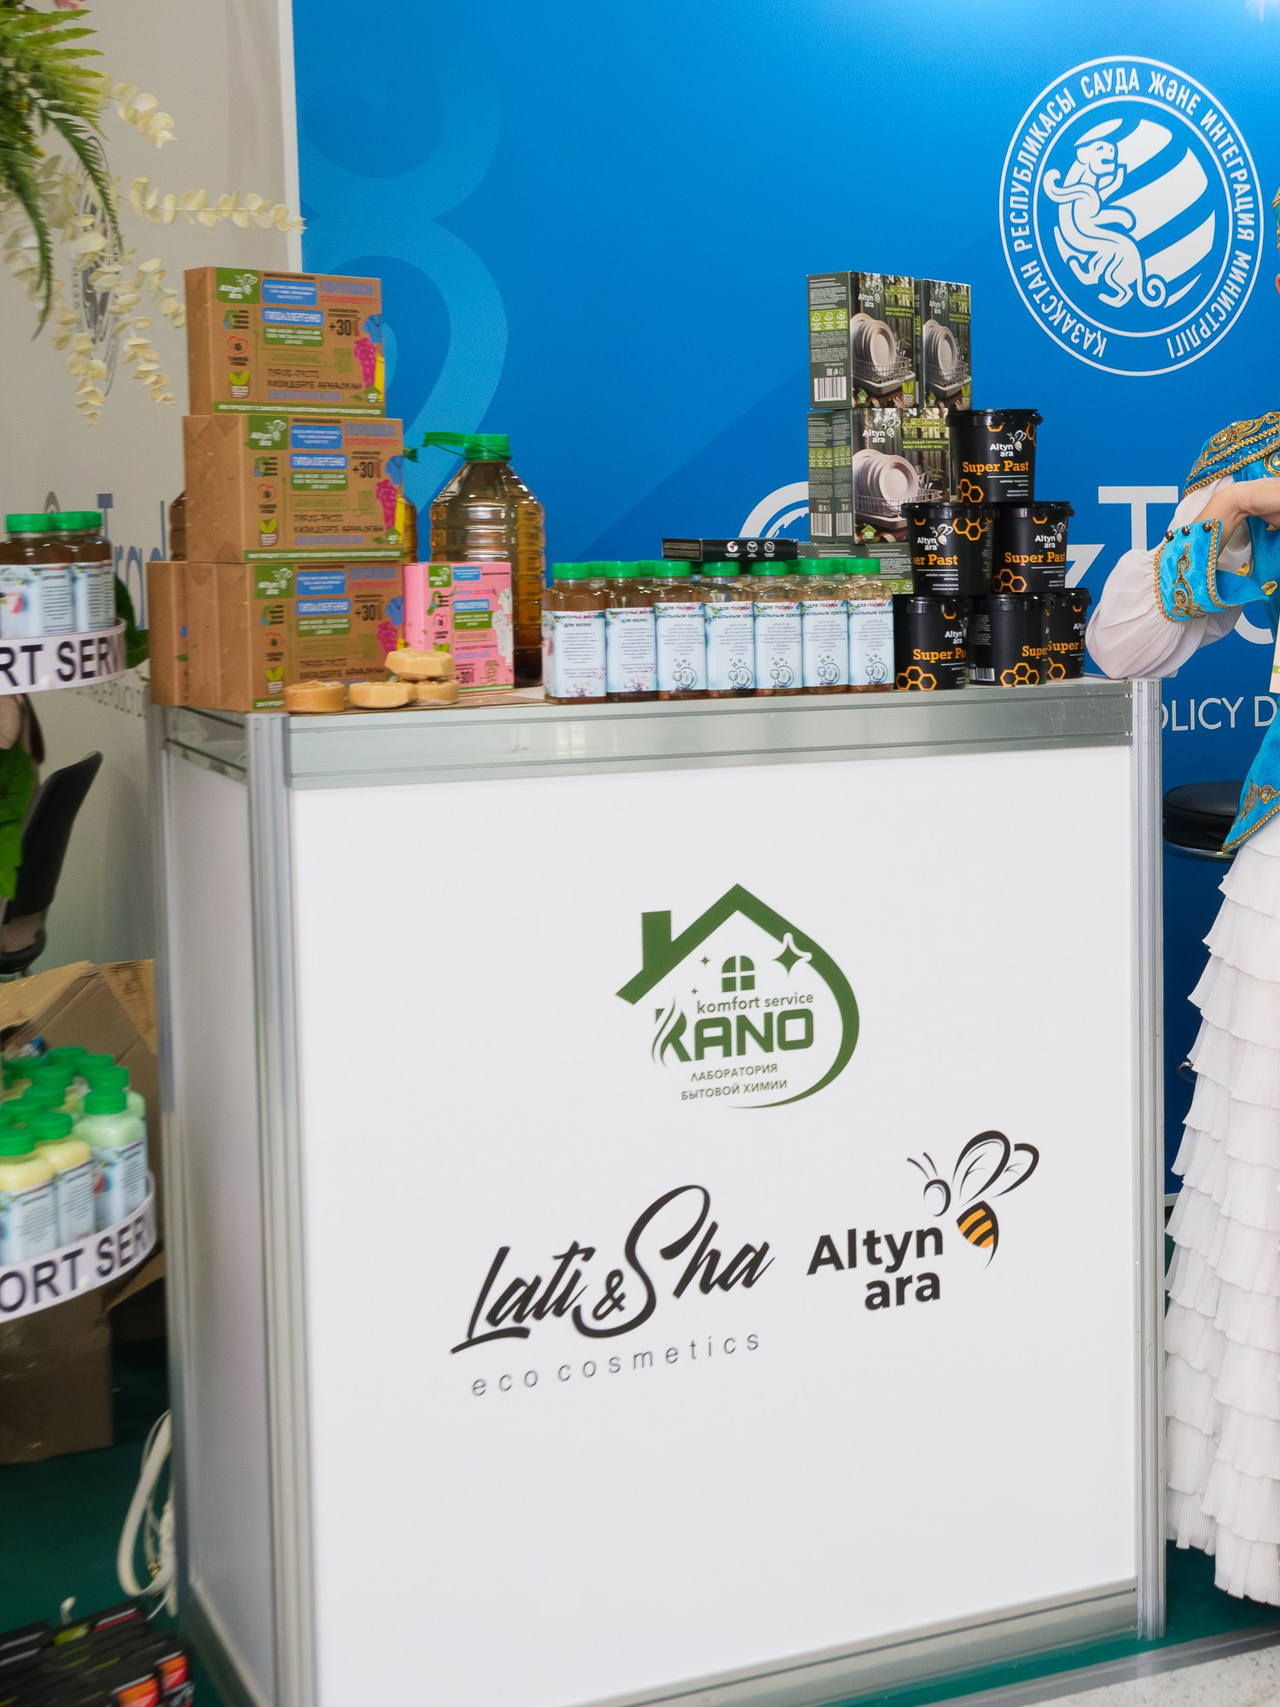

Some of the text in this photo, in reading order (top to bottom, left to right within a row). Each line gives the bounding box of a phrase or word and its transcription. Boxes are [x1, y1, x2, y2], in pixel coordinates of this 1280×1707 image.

[1010, 67, 1254, 359] ҚАЗАҚСТАН РЕСПУБЛИКАСЫ САУДА ЖӘНЕ ИНТЕГРАЦИЯ МИНИСТРЛІГІ
[862, 429, 886, 437] Altyn
[990, 443, 1014, 452] Altyn
[962, 460, 1029, 476] Super Past
[917, 537, 938, 546] Altyn
[1035, 535, 1055, 543] Altyn
[928, 554, 958, 565] Past
[1005, 552, 1044, 566] Super
[945, 630, 962, 639] Altyn
[913, 648, 966, 663] Super Pa
[1161, 695, 1277, 732] LICY D
[696, 992, 814, 1015] komfort service
[651, 999, 814, 1068] KANO
[690, 1063, 778, 1083] ЛАБОРАТОРИЯ
[681, 1079, 788, 1101] БЫТОВОЙ ХИМИИ
[96, 1215, 148, 1277] SER
[806, 1227, 944, 1277] Altyn
[864, 1271, 941, 1311] ara
[471, 1331, 760, 1398] eco cosmetics
